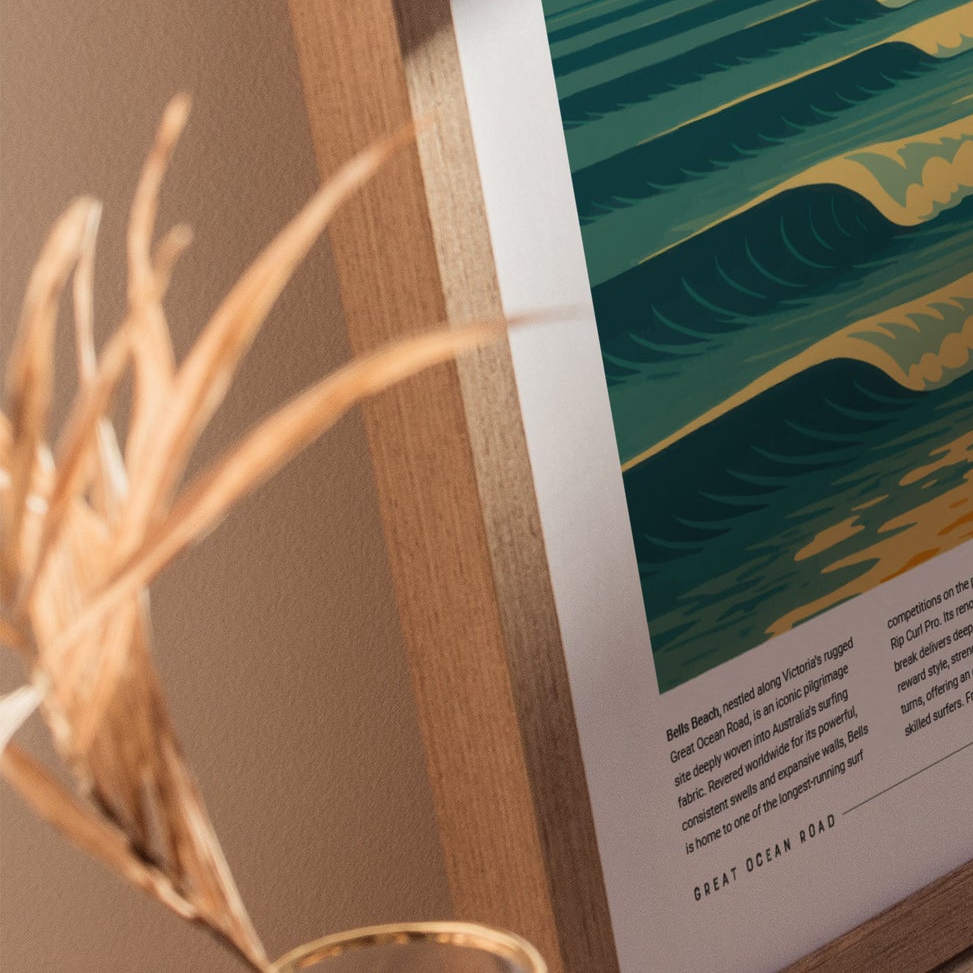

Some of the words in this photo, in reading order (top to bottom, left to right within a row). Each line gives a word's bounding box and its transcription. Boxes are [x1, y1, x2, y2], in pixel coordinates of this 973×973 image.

[886, 594, 943, 630] competitions
[942, 587, 955, 601] on
[954, 579, 970, 595] the
[889, 635, 905, 651] Rip
[905, 622, 924, 642] Curl
[923, 617, 943, 633] Pro.
[942, 609, 955, 623] Its
[665, 722, 690, 743] Bells
[690, 706, 723, 730] Beach,
[722, 686, 756, 714] nestled
[756, 675, 782, 697] along
[781, 654, 823, 682] Victoria's
[823, 636, 854, 662] rugged
[893, 651, 919, 673] break
[918, 634, 952, 660] delivers
[897, 667, 927, 693] reward
[927, 658, 951, 678] style,
[900, 695, 926, 715] turns,
[925, 676, 960, 702] offering
[959, 670, 971, 684] an
[669, 742, 696, 764] Great
[696, 727, 726, 750] Ocean
[725, 712, 753, 735] Road,
[752, 708, 762, 722] is
[762, 702, 775, 717] an
[775, 688, 803, 710] iconic
[802, 664, 849, 699] pilgrimage
[674, 770, 692, 788] site
[692, 754, 722, 778] deeply
[722, 738, 753, 762] woven
[752, 729, 772, 746] into
[772, 704, 817, 737] Australia's
[817, 688, 849, 713] surfing
[677, 787, 707, 809] fabric.
[707, 763, 745, 794] Revered
[744, 742, 791, 774] worldwide
[790, 734, 804, 750] for
[804, 728, 818, 742] its
[817, 704, 859, 739] powerful,
[904, 712, 932, 737] skilled
[932, 698, 965, 722] surfers.
[681, 798, 730, 832] consistent
[729, 783, 759, 807] swells
[759, 771, 777, 791] and
[777, 750, 821, 781] expansive
[821, 737, 847, 757] walls,
[846, 724, 870, 744] Bells
[685, 842, 695, 856] is
[694, 828, 722, 850] home
[721, 822, 733, 835] to
[733, 812, 751, 829] one
[751, 802, 762, 819] of
[762, 797, 779, 814] the
[778, 761, 847, 805] longest-running
[846, 747, 864, 768] surf
[693, 866, 737, 902] GREAT
[745, 837, 792, 873] OCEAN
[799, 813, 836, 844] ROAD
